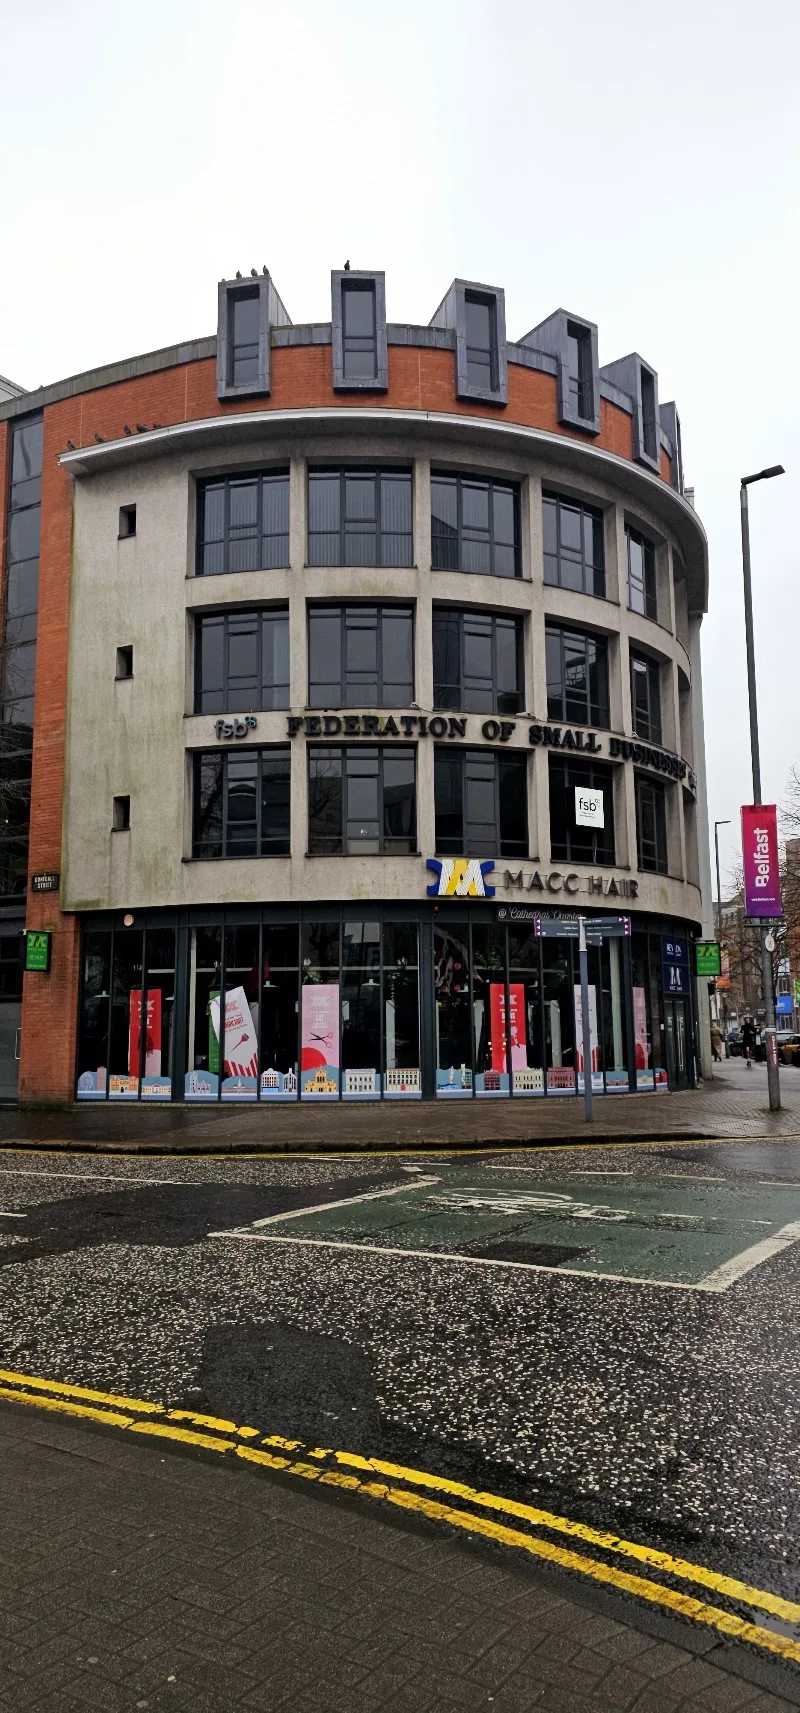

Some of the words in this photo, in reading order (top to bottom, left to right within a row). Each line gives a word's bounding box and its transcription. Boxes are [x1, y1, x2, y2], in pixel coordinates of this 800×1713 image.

[214, 718, 249, 740] fsb
[286, 715, 468, 738] FEDERATION
[482, 719, 516, 741] OF
[528, 724, 602, 753] SMALL
[578, 797, 597, 812] fsb
[753, 827, 770, 888] Belfast
[37, 881, 52, 889] STREET
[504, 869, 580, 894] MACC
[588, 875, 639, 898] HAIR
